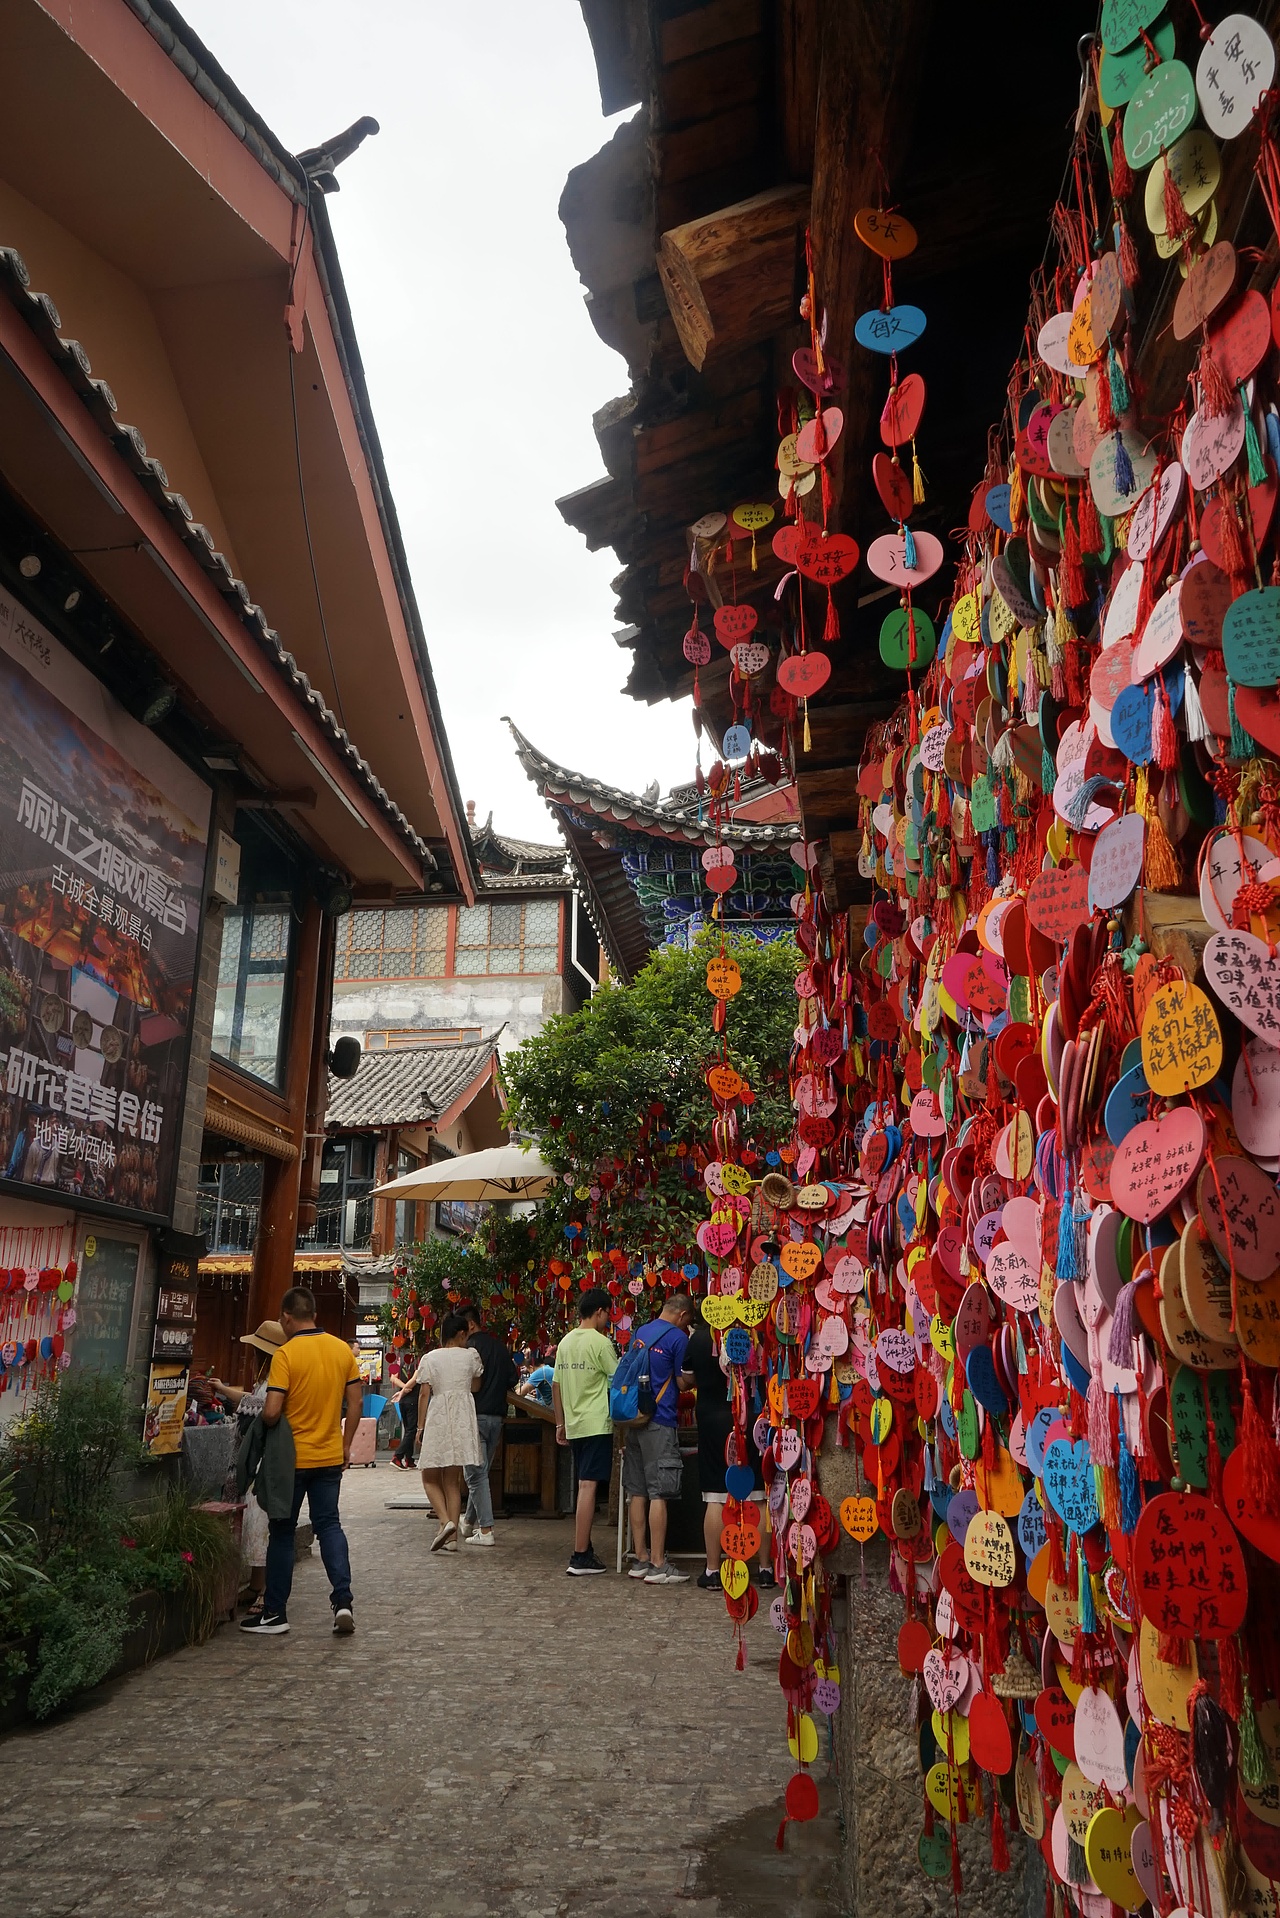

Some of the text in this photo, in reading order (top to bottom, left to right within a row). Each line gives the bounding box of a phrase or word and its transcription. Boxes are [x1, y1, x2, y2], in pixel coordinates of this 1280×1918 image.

[800, 550, 854, 568] 家人平安
[815, 566, 849, 578] 健康
[17, 777, 188, 935] 丽江之眼观景台
[51, 863, 154, 951] 古城全景观景台
[33, 1117, 117, 1168] 地道纳西味
[170, 1292, 189, 1305] 卫生间
